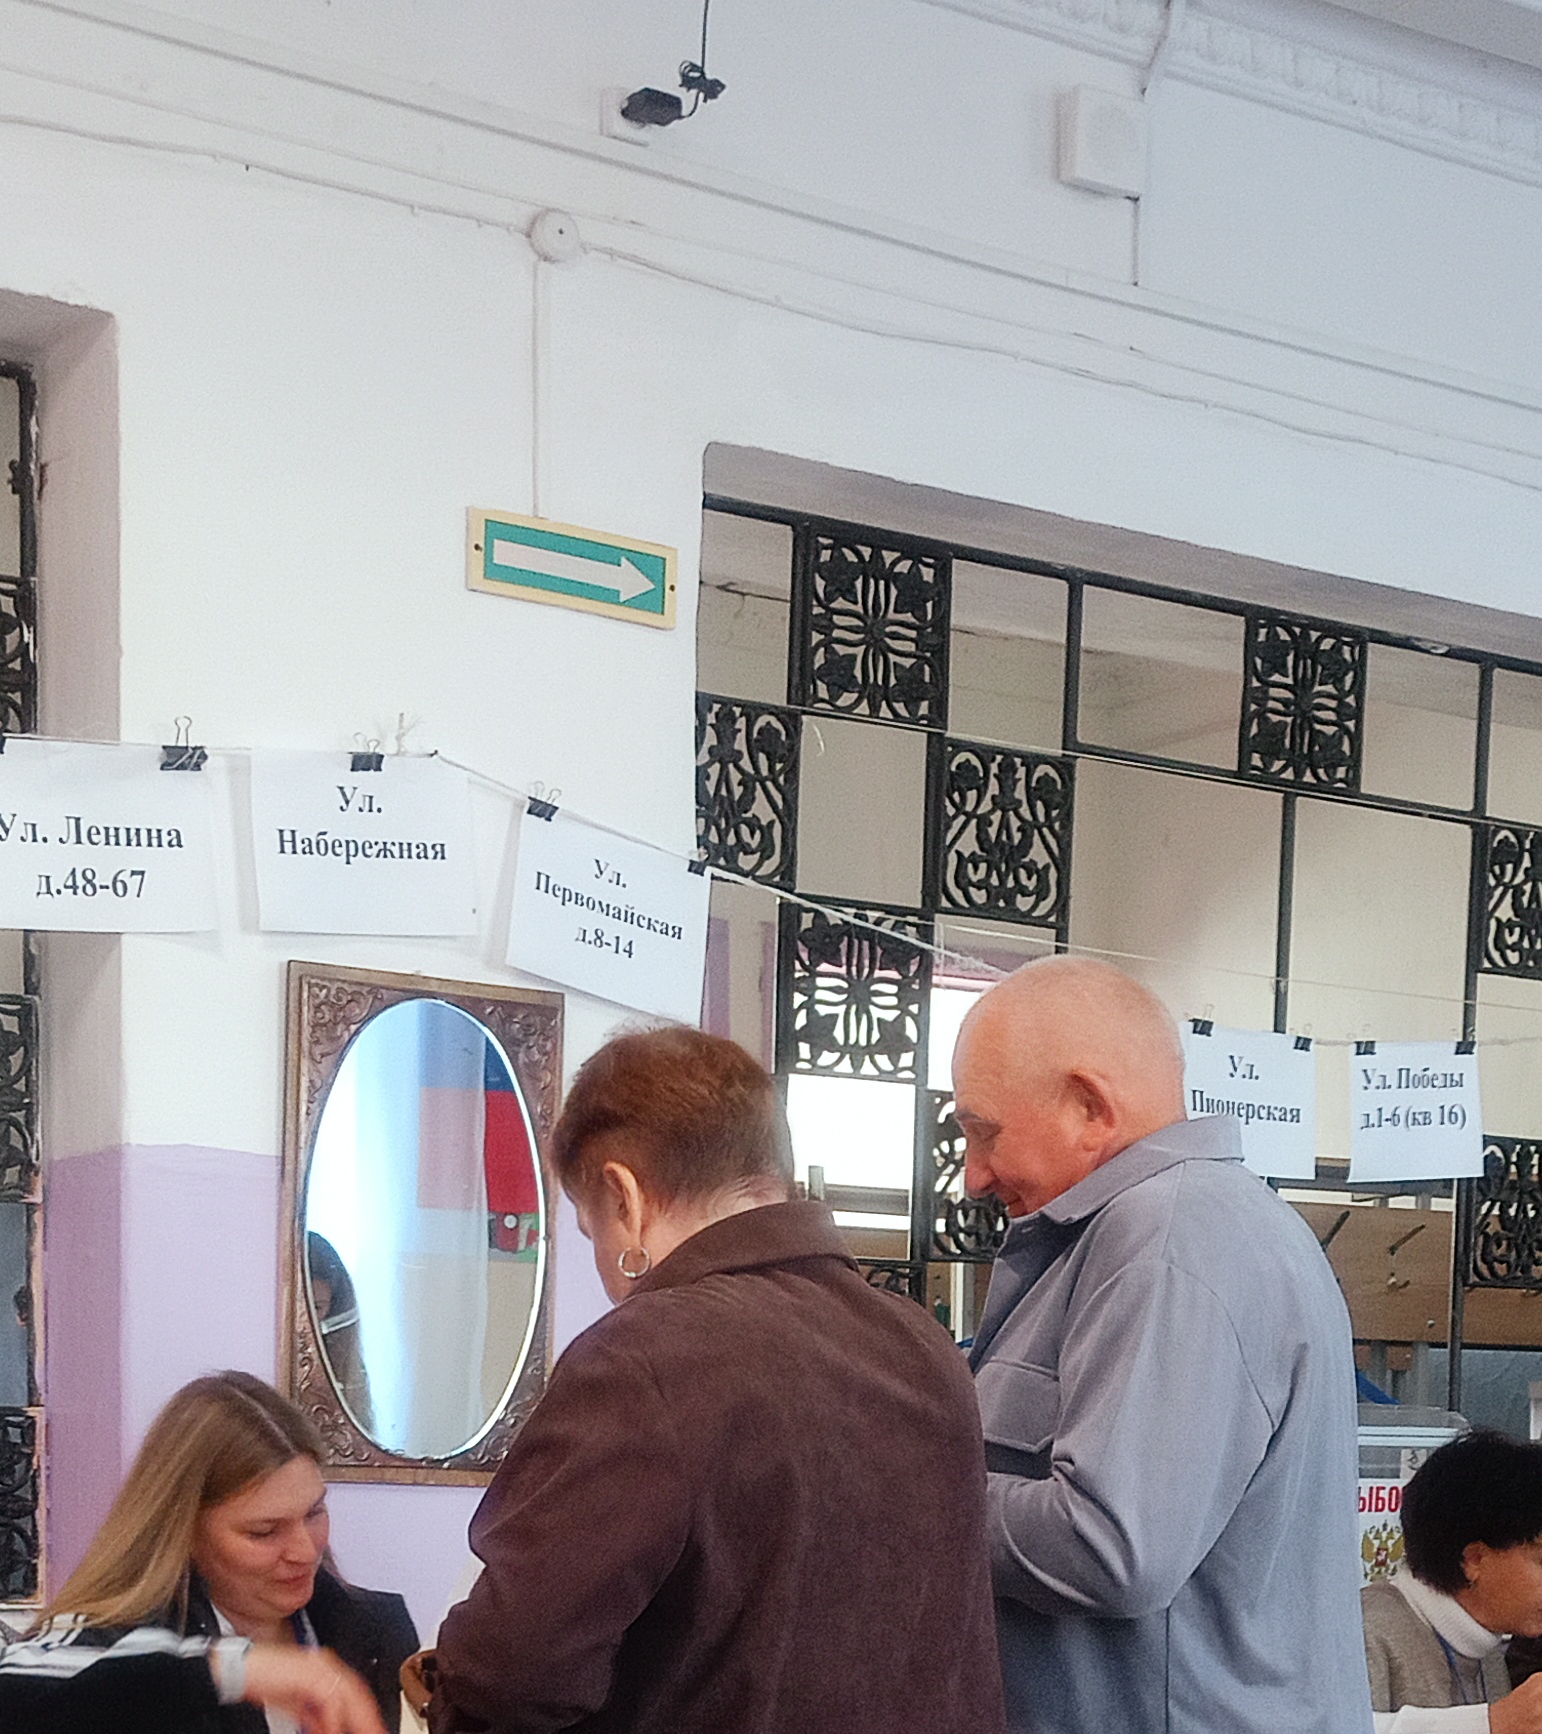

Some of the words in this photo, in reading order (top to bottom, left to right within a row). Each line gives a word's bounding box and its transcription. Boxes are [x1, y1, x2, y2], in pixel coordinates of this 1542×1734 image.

[336, 785, 383, 814] Ул.
[58, 815, 184, 849] Ленина
[276, 828, 447, 866] Набережная
[35, 867, 146, 899] д.48-67
[594, 858, 627, 888] Ул.
[535, 871, 683, 940] Первомайская
[575, 926, 634, 959] д.8-14
[1228, 1054, 1260, 1081] Ул.
[1361, 1068, 1392, 1091] Ул.
[1396, 1067, 1464, 1090] Победы
[1191, 1089, 1301, 1126] Пионерская
[1360, 1105, 1401, 1131] д.1-6
[1404, 1105, 1433, 1132] (кв
[1438, 1103, 1467, 1131] 16)
[1358, 1485, 1402, 1513] ЫБО
